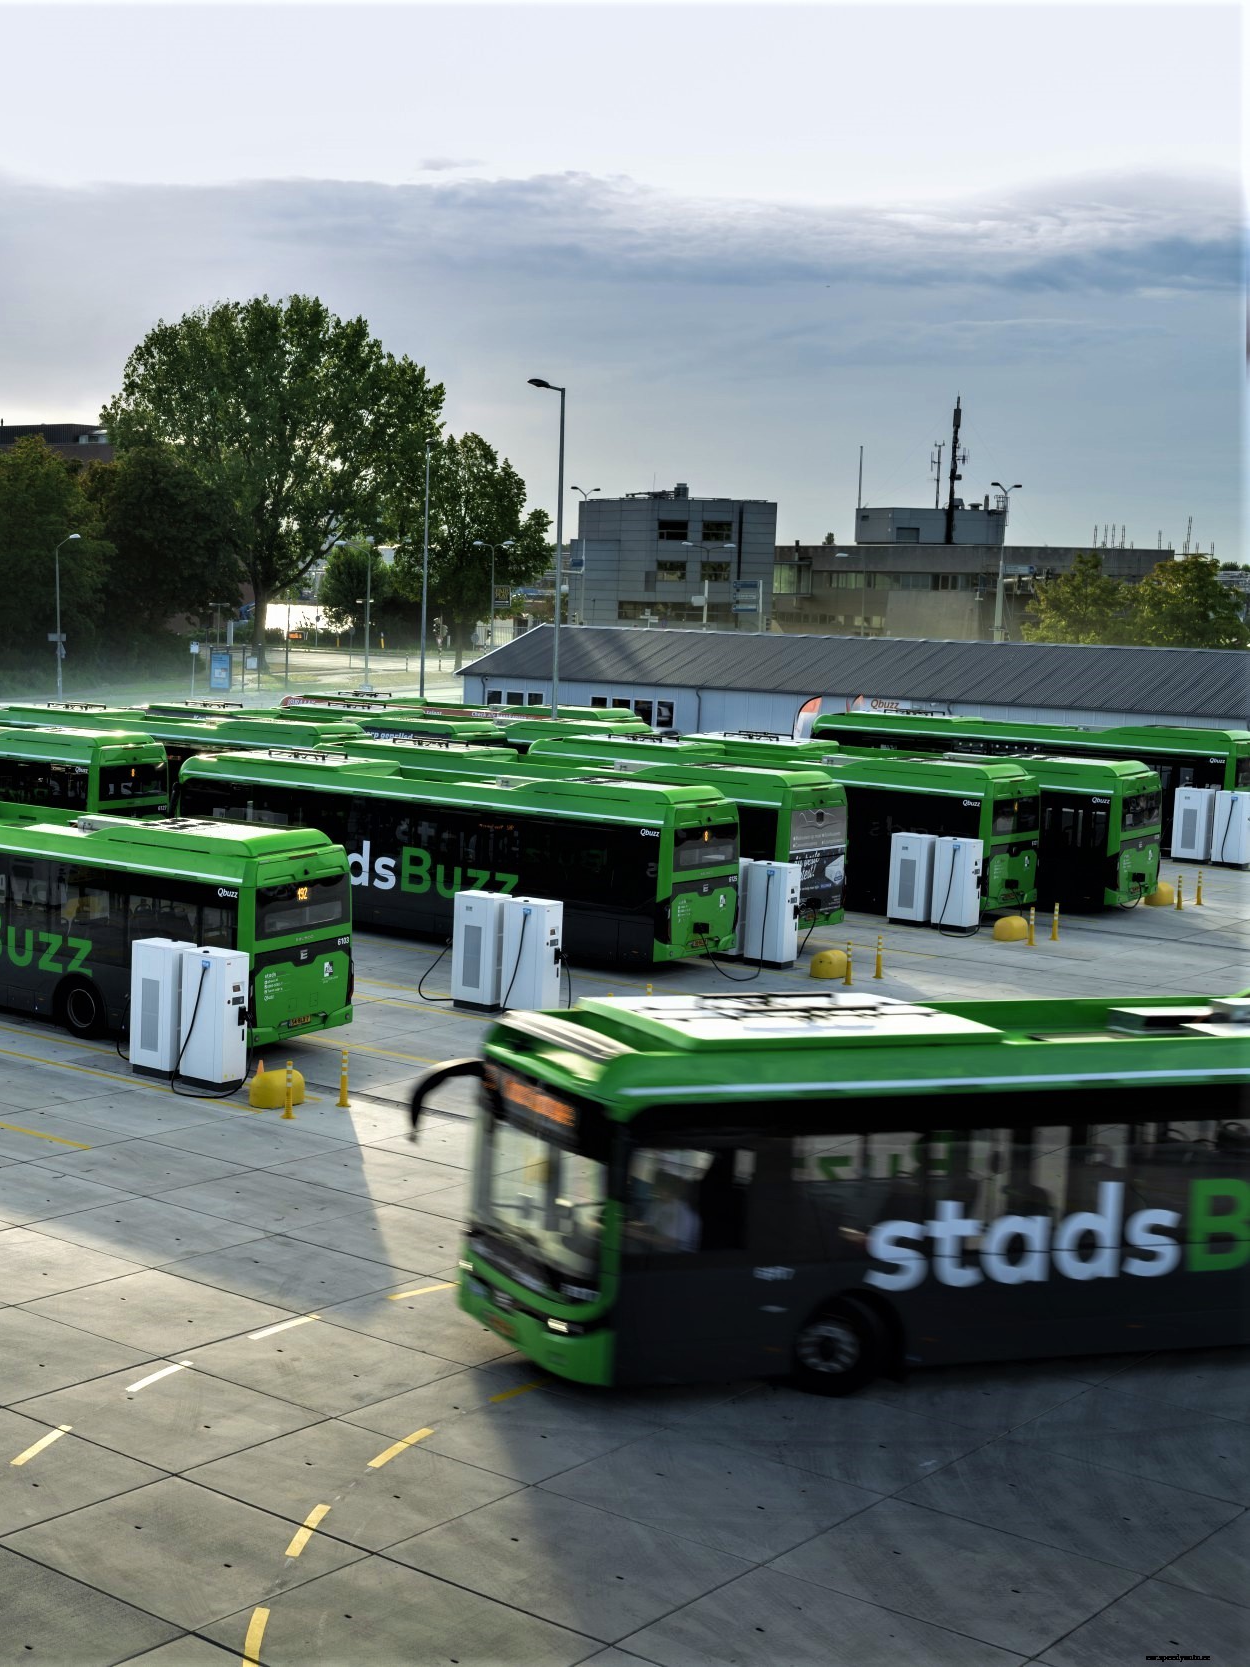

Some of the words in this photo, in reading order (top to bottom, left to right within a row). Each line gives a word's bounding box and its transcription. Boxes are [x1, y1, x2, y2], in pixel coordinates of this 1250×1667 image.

[870, 699, 900, 710] Qbuzz
[962, 799, 981, 808] Qbuzz
[1091, 796, 1111, 805] Qbuzz
[639, 828, 660, 838] Qbuzz
[217, 887, 239, 899] Qbuzz
[296, 887, 308, 900] 192
[337, 936, 350, 946] 6103
